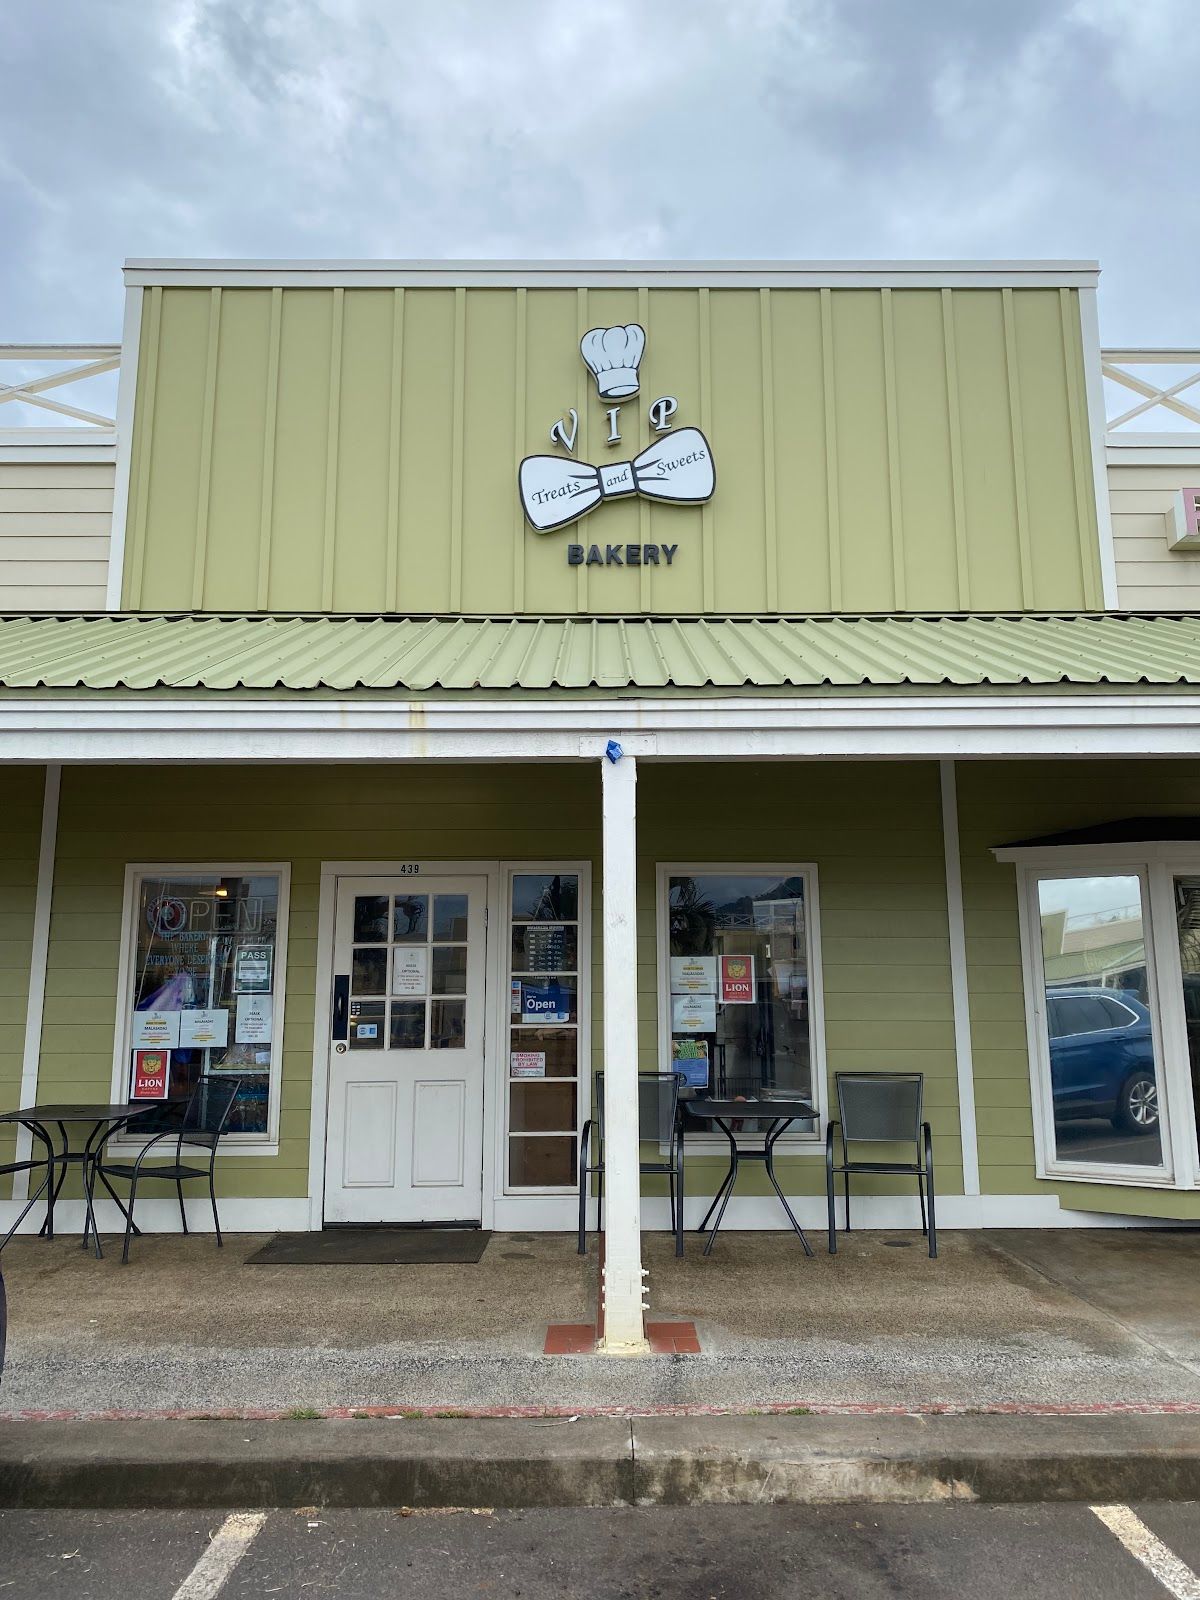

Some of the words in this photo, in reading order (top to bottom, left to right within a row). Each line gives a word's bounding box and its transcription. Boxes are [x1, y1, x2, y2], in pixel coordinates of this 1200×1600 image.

[531, 480, 581, 505] Treats
[606, 469, 629, 487] and
[656, 449, 706, 477] Sweets
[567, 544, 678, 565] BAKERY
[400, 864, 420, 874] 439
[163, 900, 258, 932] OPEN
[171, 943, 198, 953] WHERE
[146, 955, 185, 966] EVERYONE
[241, 951, 266, 960] PASS
[725, 983, 750, 992] LION
[526, 999, 556, 1011] Open
[138, 1079, 163, 1087] LION
